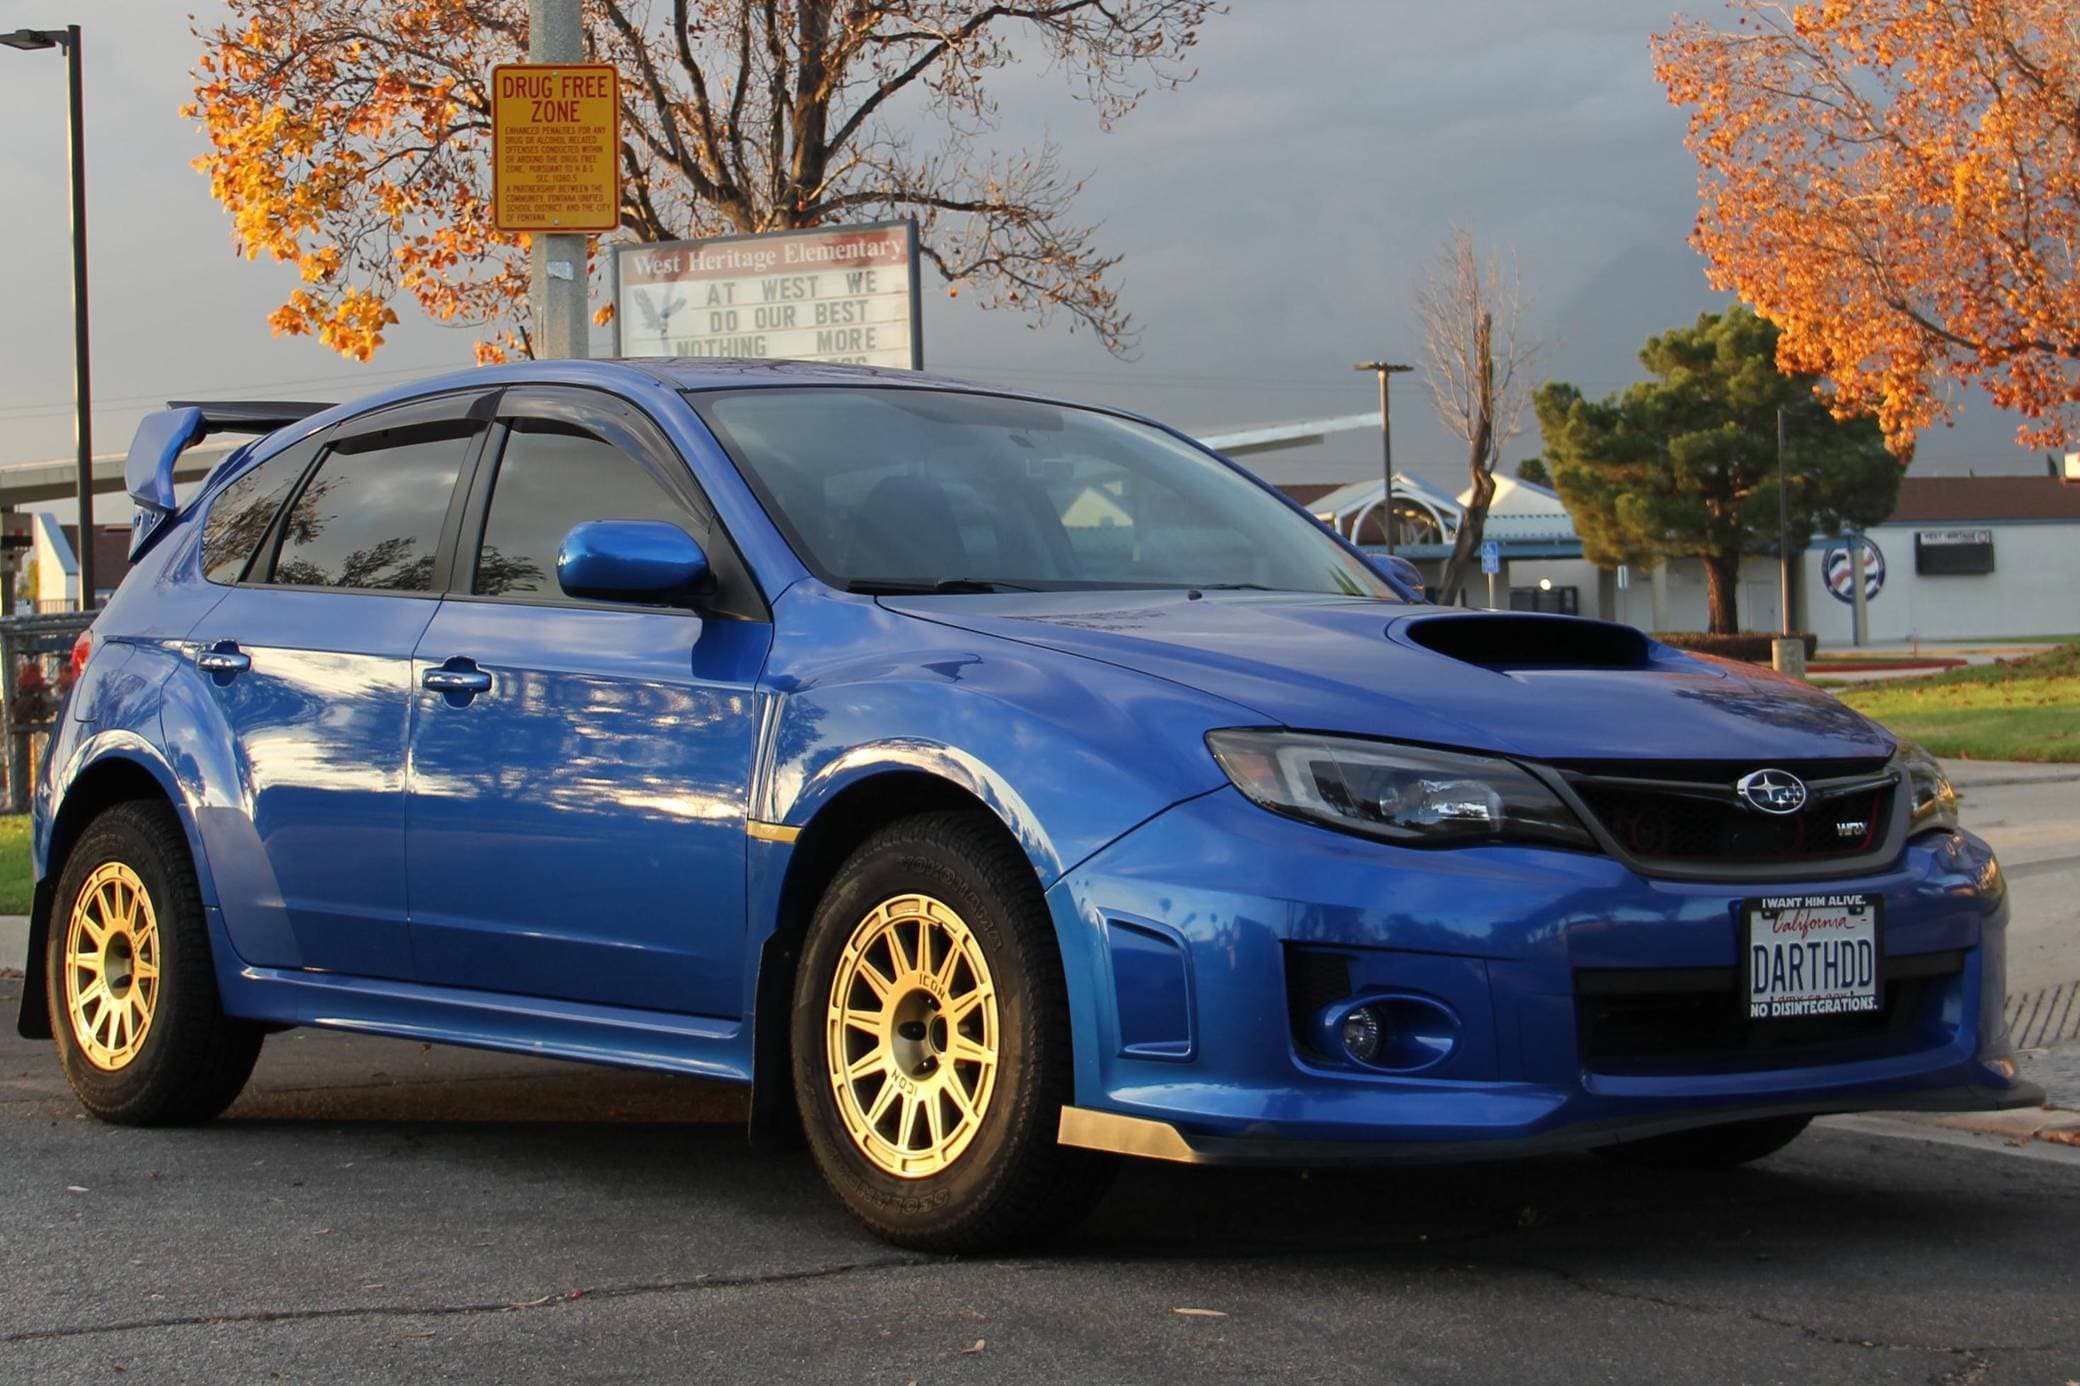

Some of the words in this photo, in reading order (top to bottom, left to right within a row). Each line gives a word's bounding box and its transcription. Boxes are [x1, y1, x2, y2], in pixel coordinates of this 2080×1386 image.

[503, 76, 552, 98] DRUG
[562, 76, 608, 98] FREE
[531, 101, 581, 123] ZONE
[505, 127, 540, 135] ENHANCED
[542, 127, 575, 135] PENALTIES
[578, 127, 590, 135] FOR
[594, 127, 606, 135] ANY
[505, 136, 523, 145] DRUG
[526, 136, 535, 145] OR
[538, 136, 566, 145] ALCOHOL
[569, 136, 597, 145] RELATED
[505, 146, 539, 154] OFFENSES
[541, 146, 578, 154] CONDUCTED
[546, 155, 558, 164] THE
[581, 155, 598, 164] FREE
[567, 204, 580, 212] AND
[597, 204, 611, 212] CITY
[633, 254, 680, 275] West
[689, 248, 776, 271] Heritage
[784, 237, 903, 264] Elementary
[707, 282, 736, 306] AT
[762, 275, 819, 300] WEST
[846, 270, 877, 294] WE
[710, 310, 738, 333] DO
[755, 304, 796, 329] OUR
[815, 299, 869, 324] BEST
[676, 335, 767, 357] NOTHING
[817, 327, 876, 353] MORE
[1836, 822, 1868, 836] WRX
[896, 855, 1004, 952] YOKOHAMA
[1805, 896, 1825, 906] HIM
[1828, 895, 1866, 906] ALIVE.
[1772, 909, 1856, 939] California
[1753, 939, 1873, 995] DARTHDD
[919, 973, 945, 1000] ICON
[1750, 1002, 1768, 1018] NO
[1772, 996, 1877, 1017] DISINTEGRATIONS.
[891, 1069, 918, 1097] ICON
